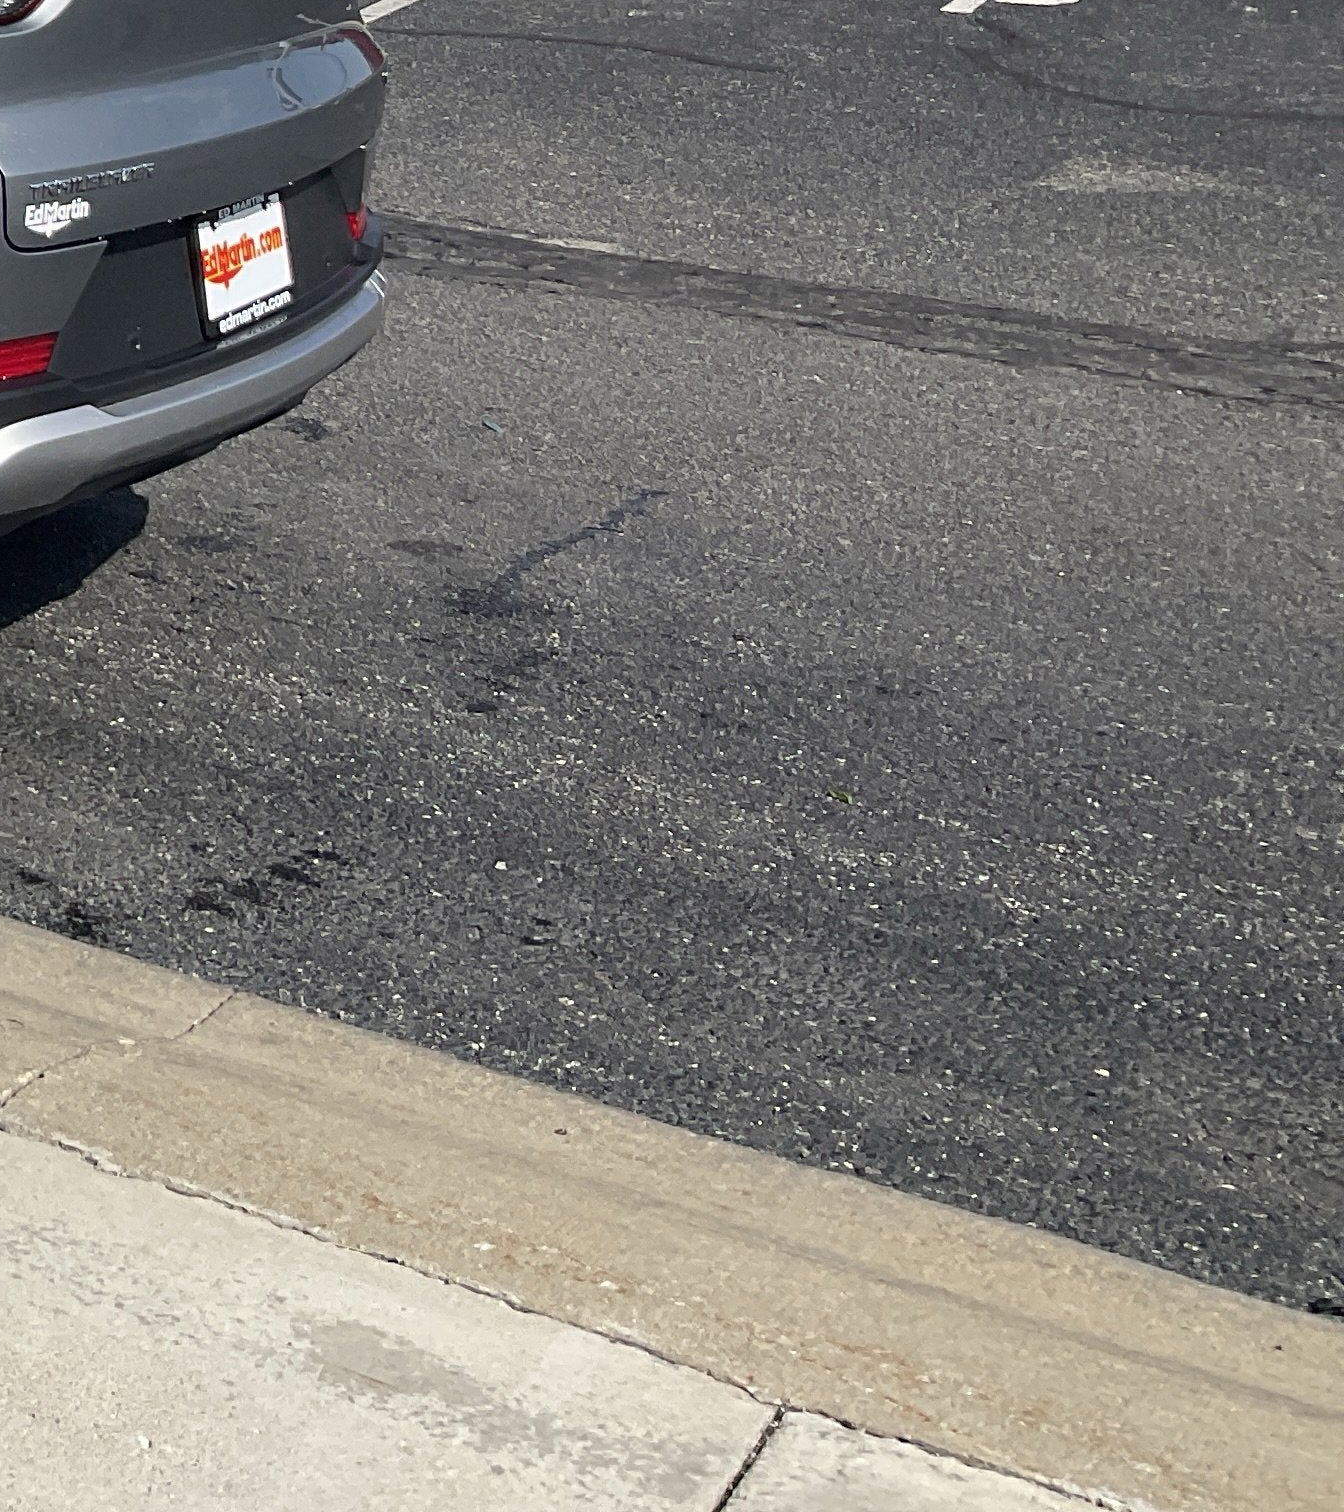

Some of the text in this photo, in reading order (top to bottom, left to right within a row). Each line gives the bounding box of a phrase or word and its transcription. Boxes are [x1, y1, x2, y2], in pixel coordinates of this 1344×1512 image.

[24, 196, 90, 227] EdMartin
[218, 207, 232, 219] ED
[201, 226, 283, 277] EdMartin.com
[219, 290, 292, 334] edmartin.com
